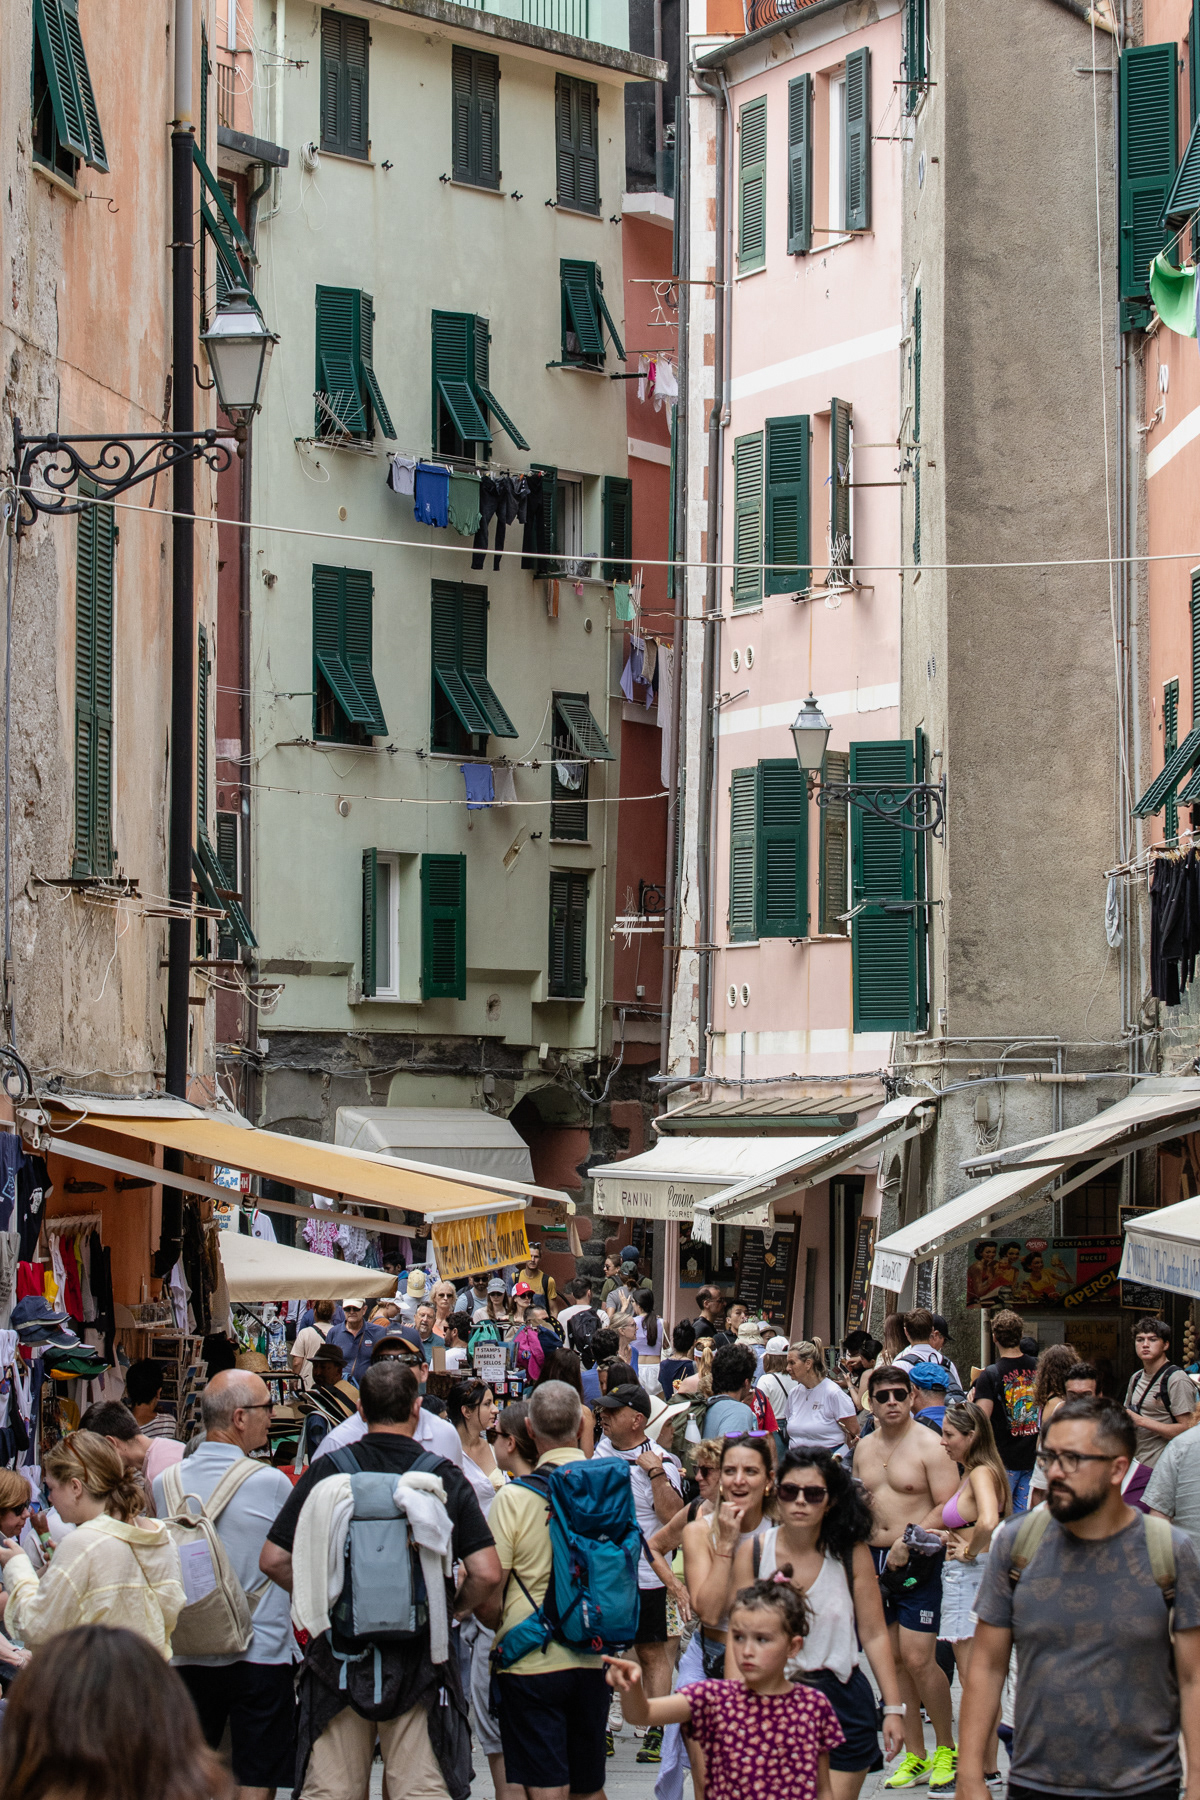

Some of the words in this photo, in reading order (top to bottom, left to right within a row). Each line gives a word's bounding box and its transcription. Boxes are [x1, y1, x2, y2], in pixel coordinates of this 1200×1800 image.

[621, 1191, 652, 1207] PANINI
[667, 1184, 695, 1209] Panino
[668, 1209, 693, 1218] GOURMET
[1053, 1239, 1092, 1248] COCKTAILS
[1080, 1254, 1106, 1262] BUCKET
[1064, 1270, 1119, 1308] APEROL
